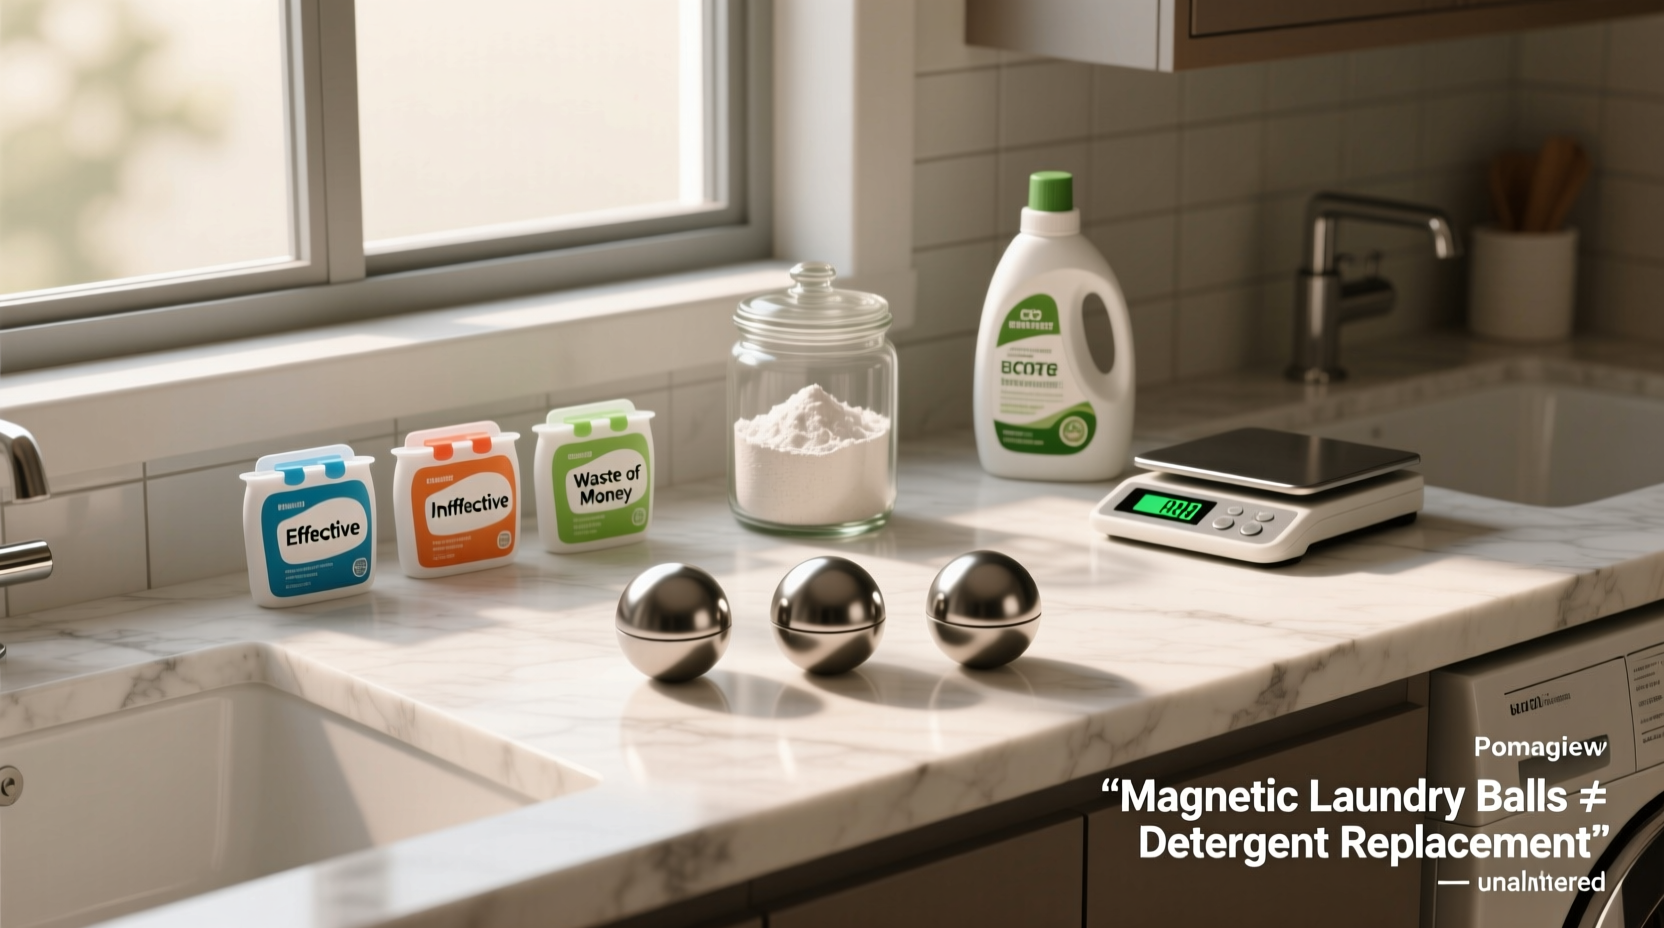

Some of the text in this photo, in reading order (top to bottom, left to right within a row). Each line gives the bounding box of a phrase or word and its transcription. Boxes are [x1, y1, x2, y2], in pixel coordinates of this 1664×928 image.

[573, 464, 642, 488] Waste of
[580, 487, 633, 506] Money
[286, 519, 361, 547] Effective
